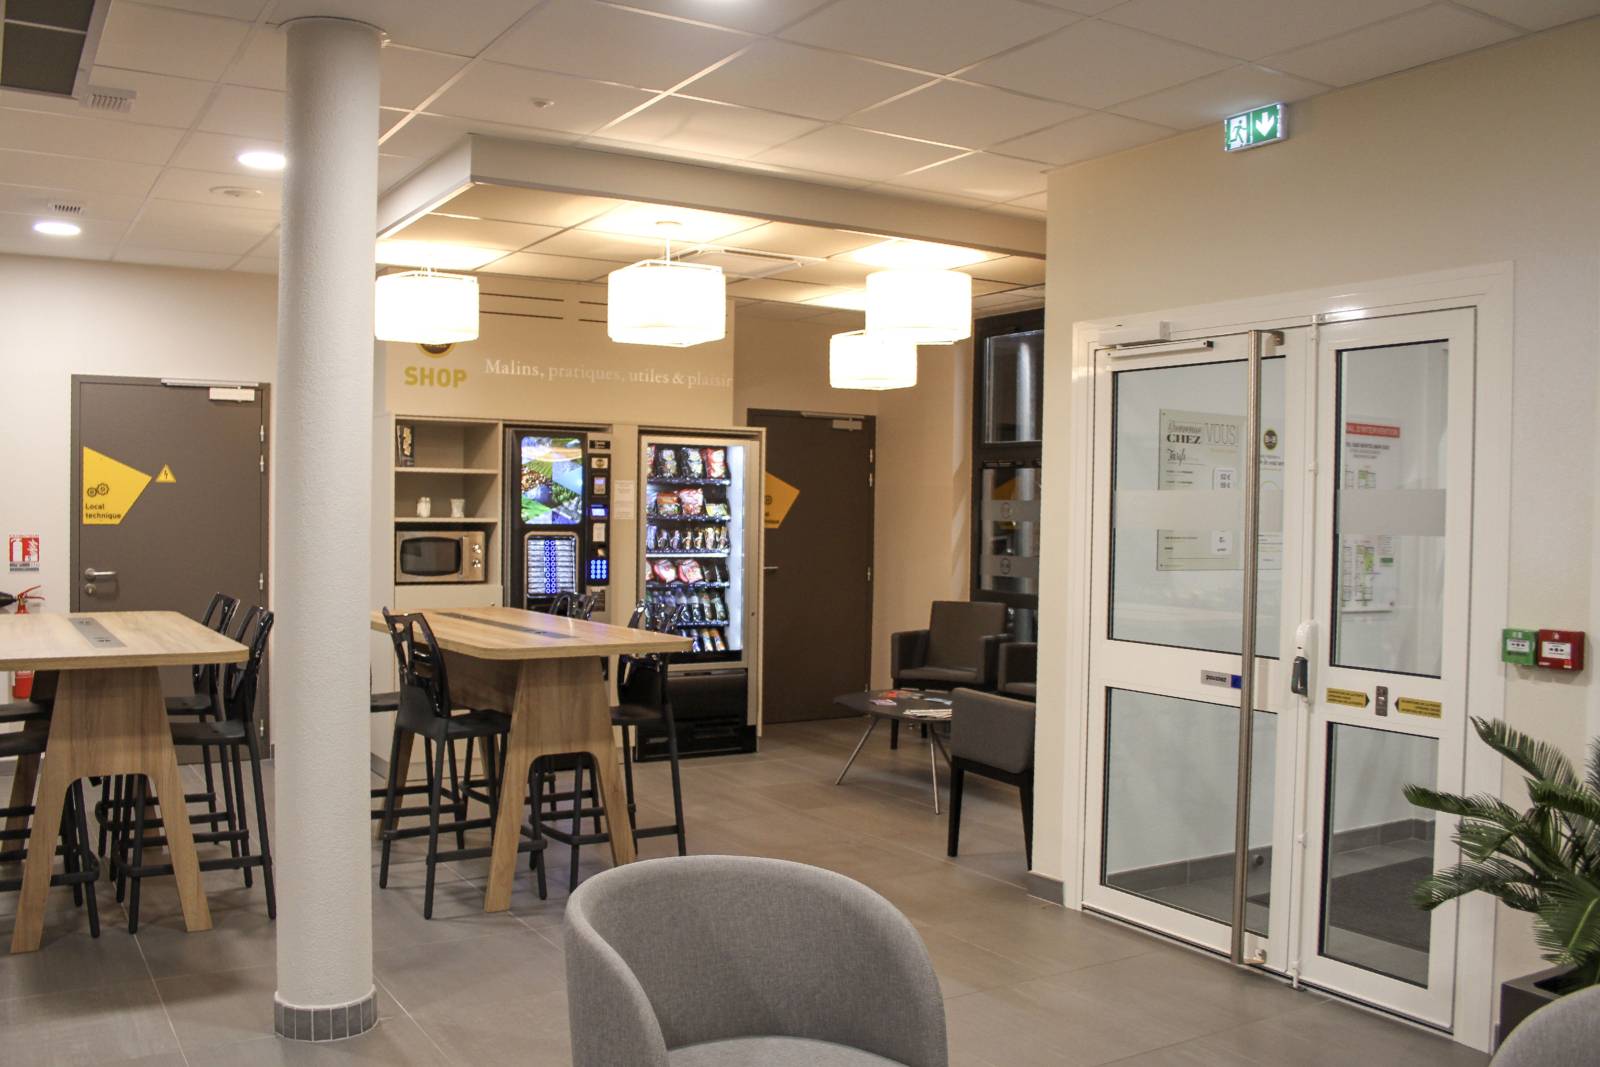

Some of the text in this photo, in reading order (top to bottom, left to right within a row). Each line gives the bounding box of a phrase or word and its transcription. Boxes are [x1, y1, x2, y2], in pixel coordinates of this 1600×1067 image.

[404, 366, 467, 388] SHOP
[485, 359, 544, 378] Malins,
[548, 363, 626, 383] pratiques,
[629, 368, 670, 384] utiles
[672, 372, 684, 385] &
[1166, 433, 1201, 445] CHEZ
